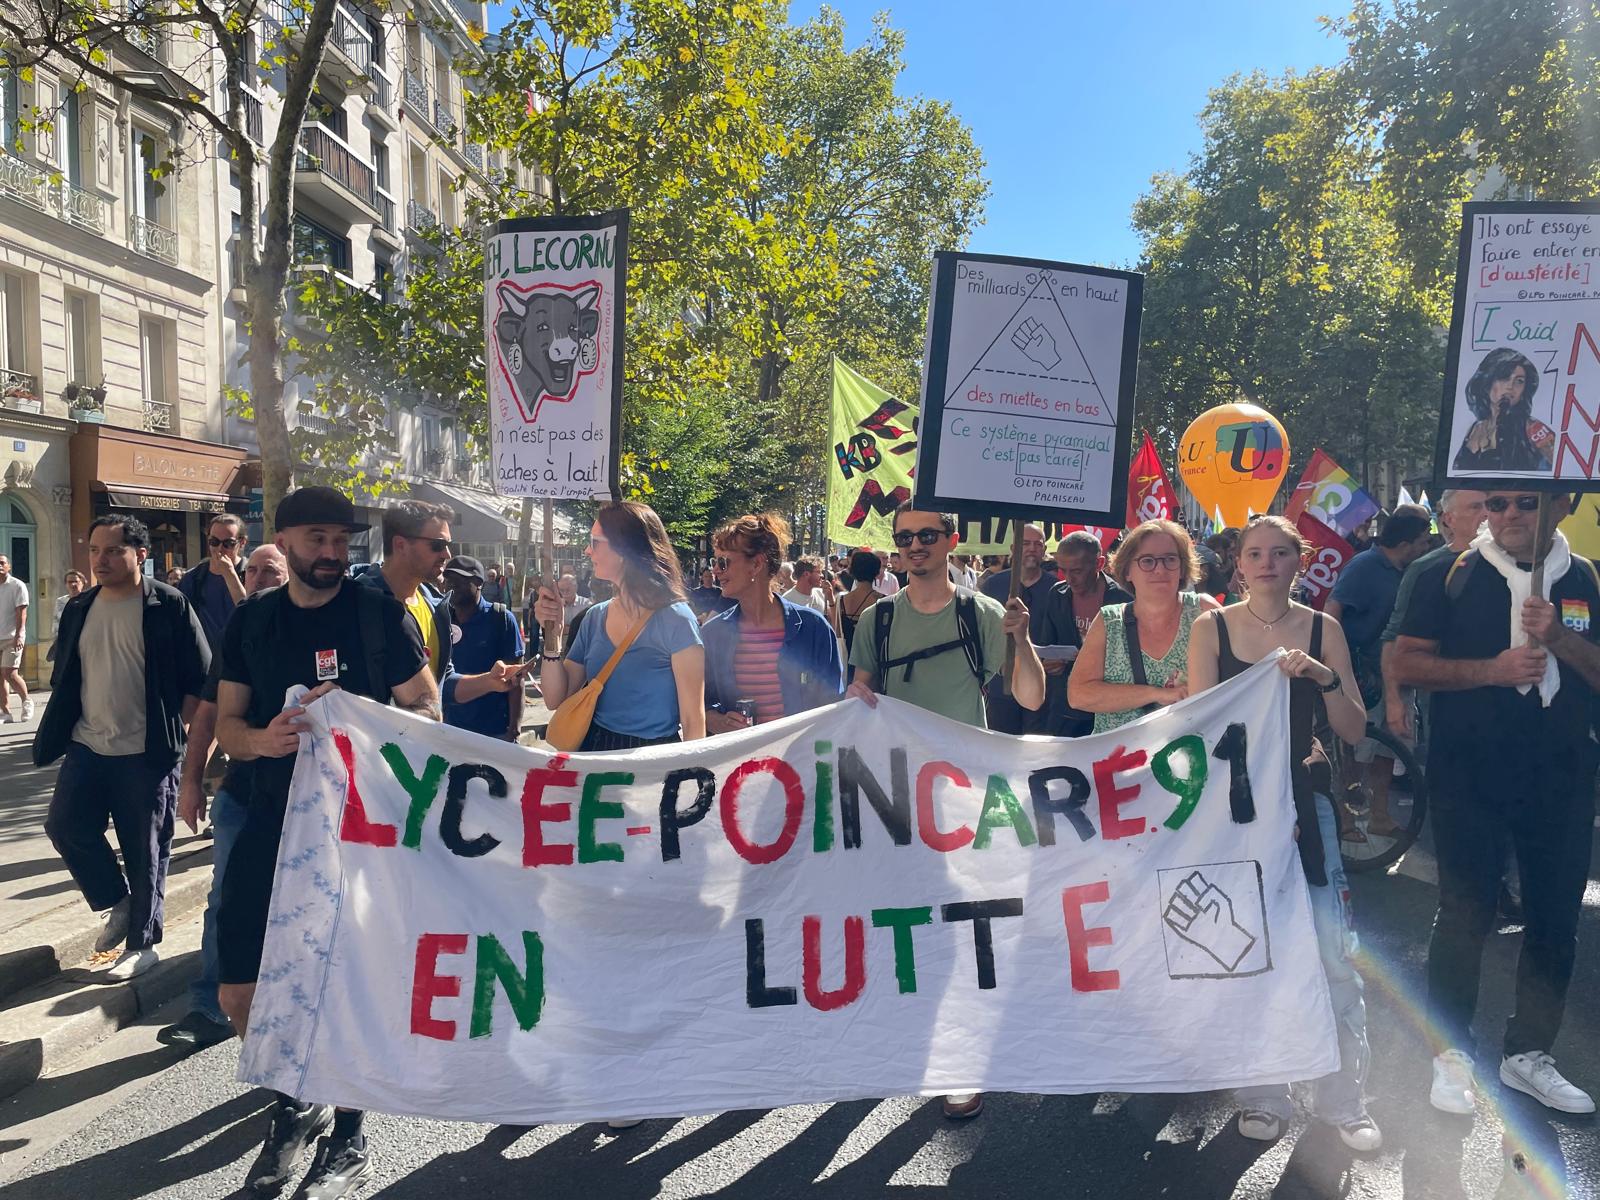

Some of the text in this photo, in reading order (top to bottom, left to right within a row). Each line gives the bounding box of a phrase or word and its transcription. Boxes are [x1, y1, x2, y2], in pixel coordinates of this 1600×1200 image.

[1478, 216, 1592, 241] Ils ont essayé
[513, 231, 617, 274] LECORNU
[1481, 242, 1521, 263] faire
[1533, 241, 1577, 257] entrer
[958, 264, 985, 281] Des
[967, 278, 1027, 297] milliards
[1061, 280, 1119, 303] en haut
[1475, 307, 1501, 343] I
[967, 385, 1100, 417] des miettes en bas
[510, 425, 545, 444] n'est
[548, 430, 576, 456] pas
[581, 421, 604, 442] des
[950, 417, 1110, 456] Ce système pyramidal
[544, 458, 558, 481] à
[1017, 451, 1041, 474] pas
[1046, 478, 1084, 491] POINCARÉ
[140, 495, 180, 509] PATISSERIES
[1034, 491, 1085, 504] PALAISEAU
[411, 881, 1120, 1041] EN LUTTE
